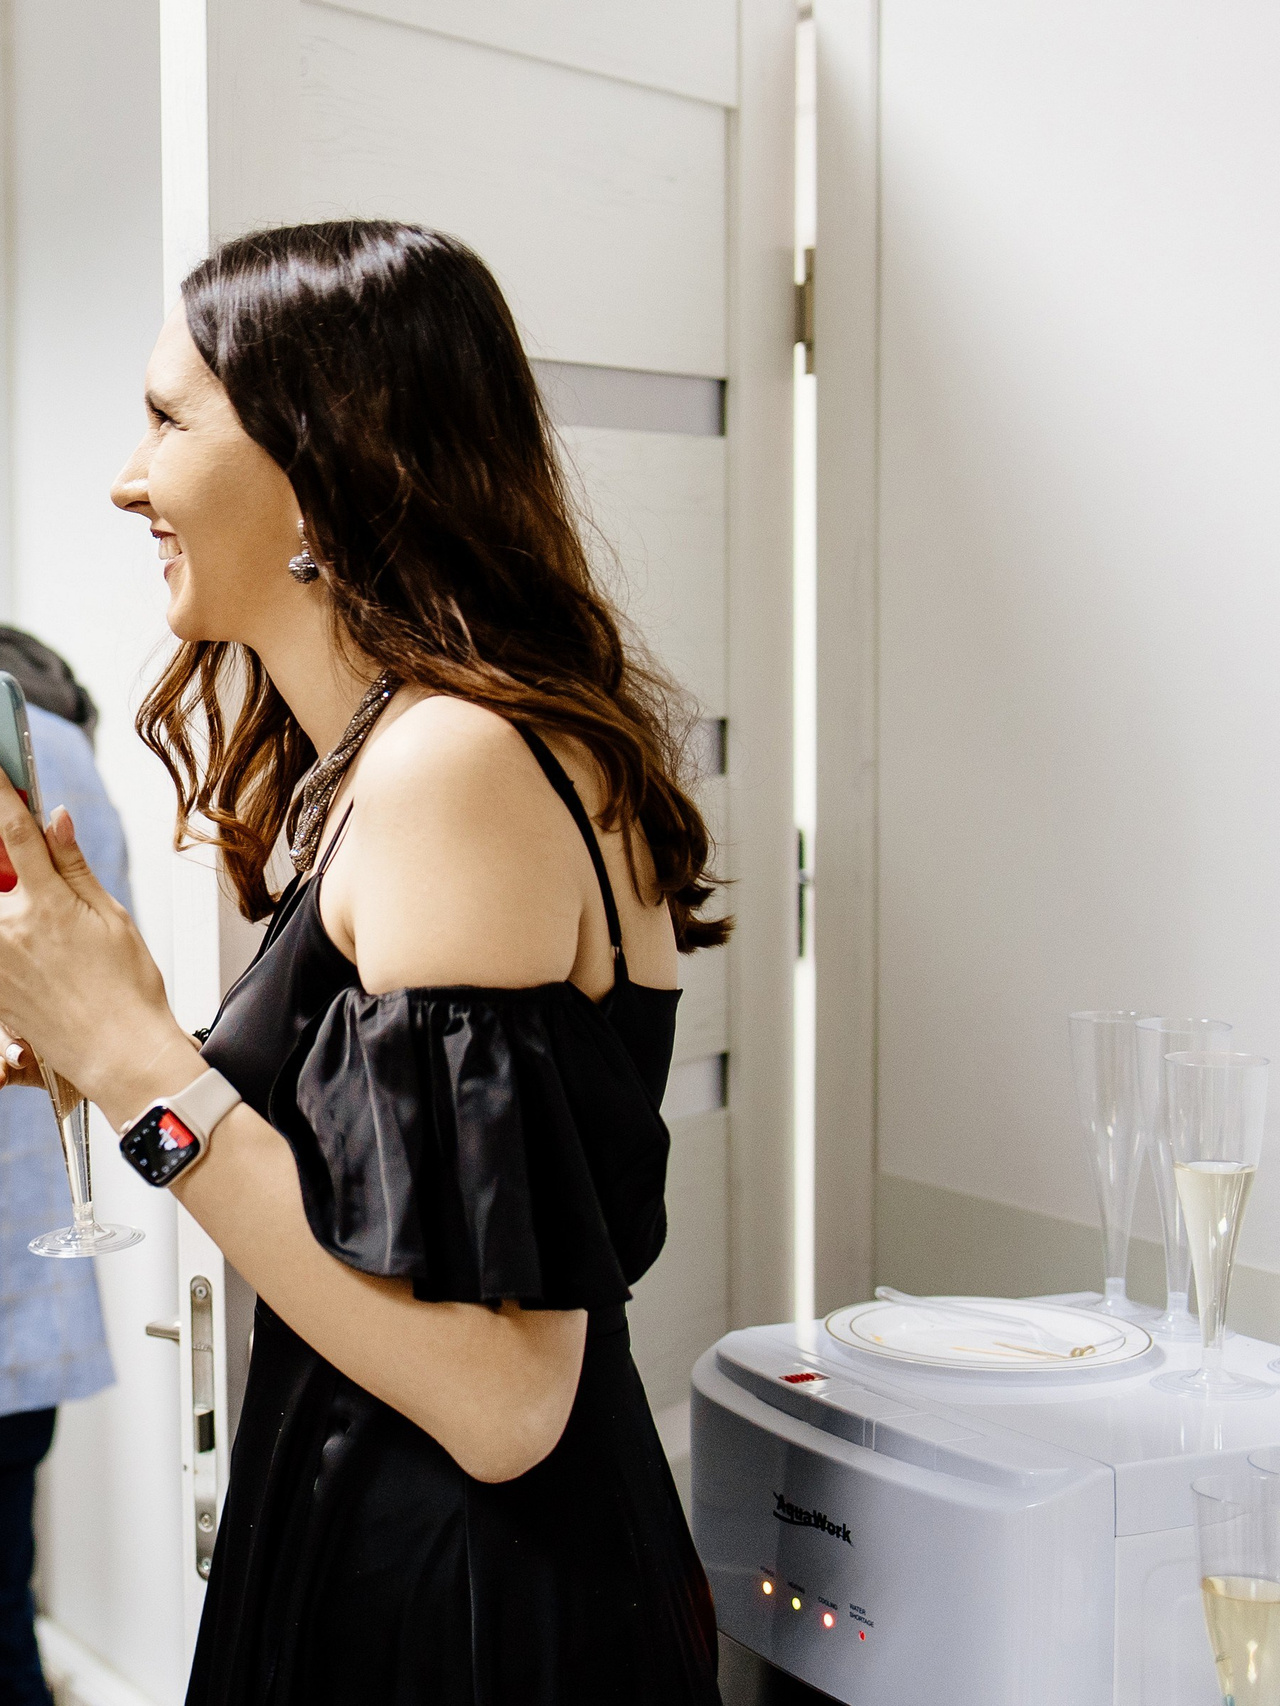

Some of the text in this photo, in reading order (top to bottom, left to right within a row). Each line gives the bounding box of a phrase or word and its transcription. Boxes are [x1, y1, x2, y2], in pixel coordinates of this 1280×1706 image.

[773, 1492, 854, 1546] AquaWork
[849, 1603, 866, 1615] WATER
[849, 1612, 874, 1628] SHORTAGE
